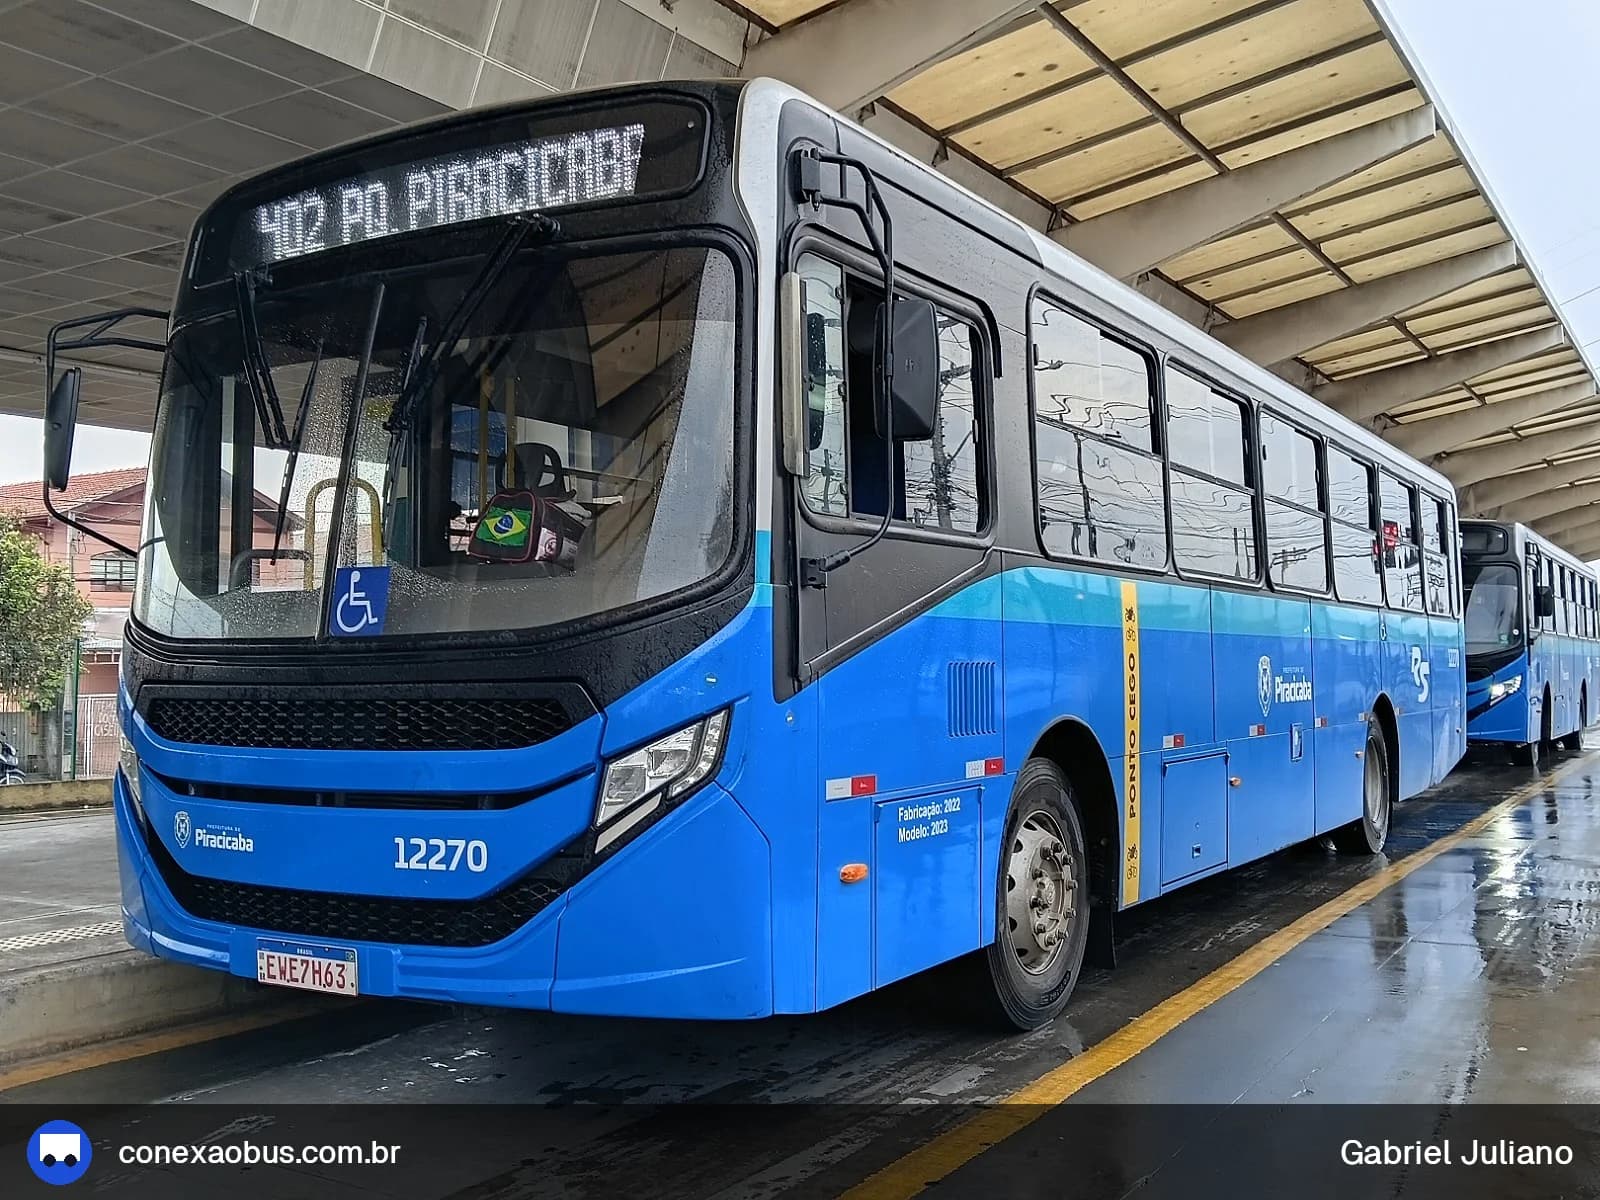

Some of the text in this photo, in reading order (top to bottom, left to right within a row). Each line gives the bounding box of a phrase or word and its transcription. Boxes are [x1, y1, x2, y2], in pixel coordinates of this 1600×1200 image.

[259, 195, 325, 259] 402
[1275, 674, 1312, 703] Piracicaba
[1128, 652, 1137, 819] PONTO CEGO
[899, 797, 961, 821] Fabricação: 2022
[195, 828, 254, 853] Piracicaba
[898, 819, 949, 843] Modelo: 2023
[394, 837, 488, 873] 12270
[266, 954, 347, 989] EWE7H63
